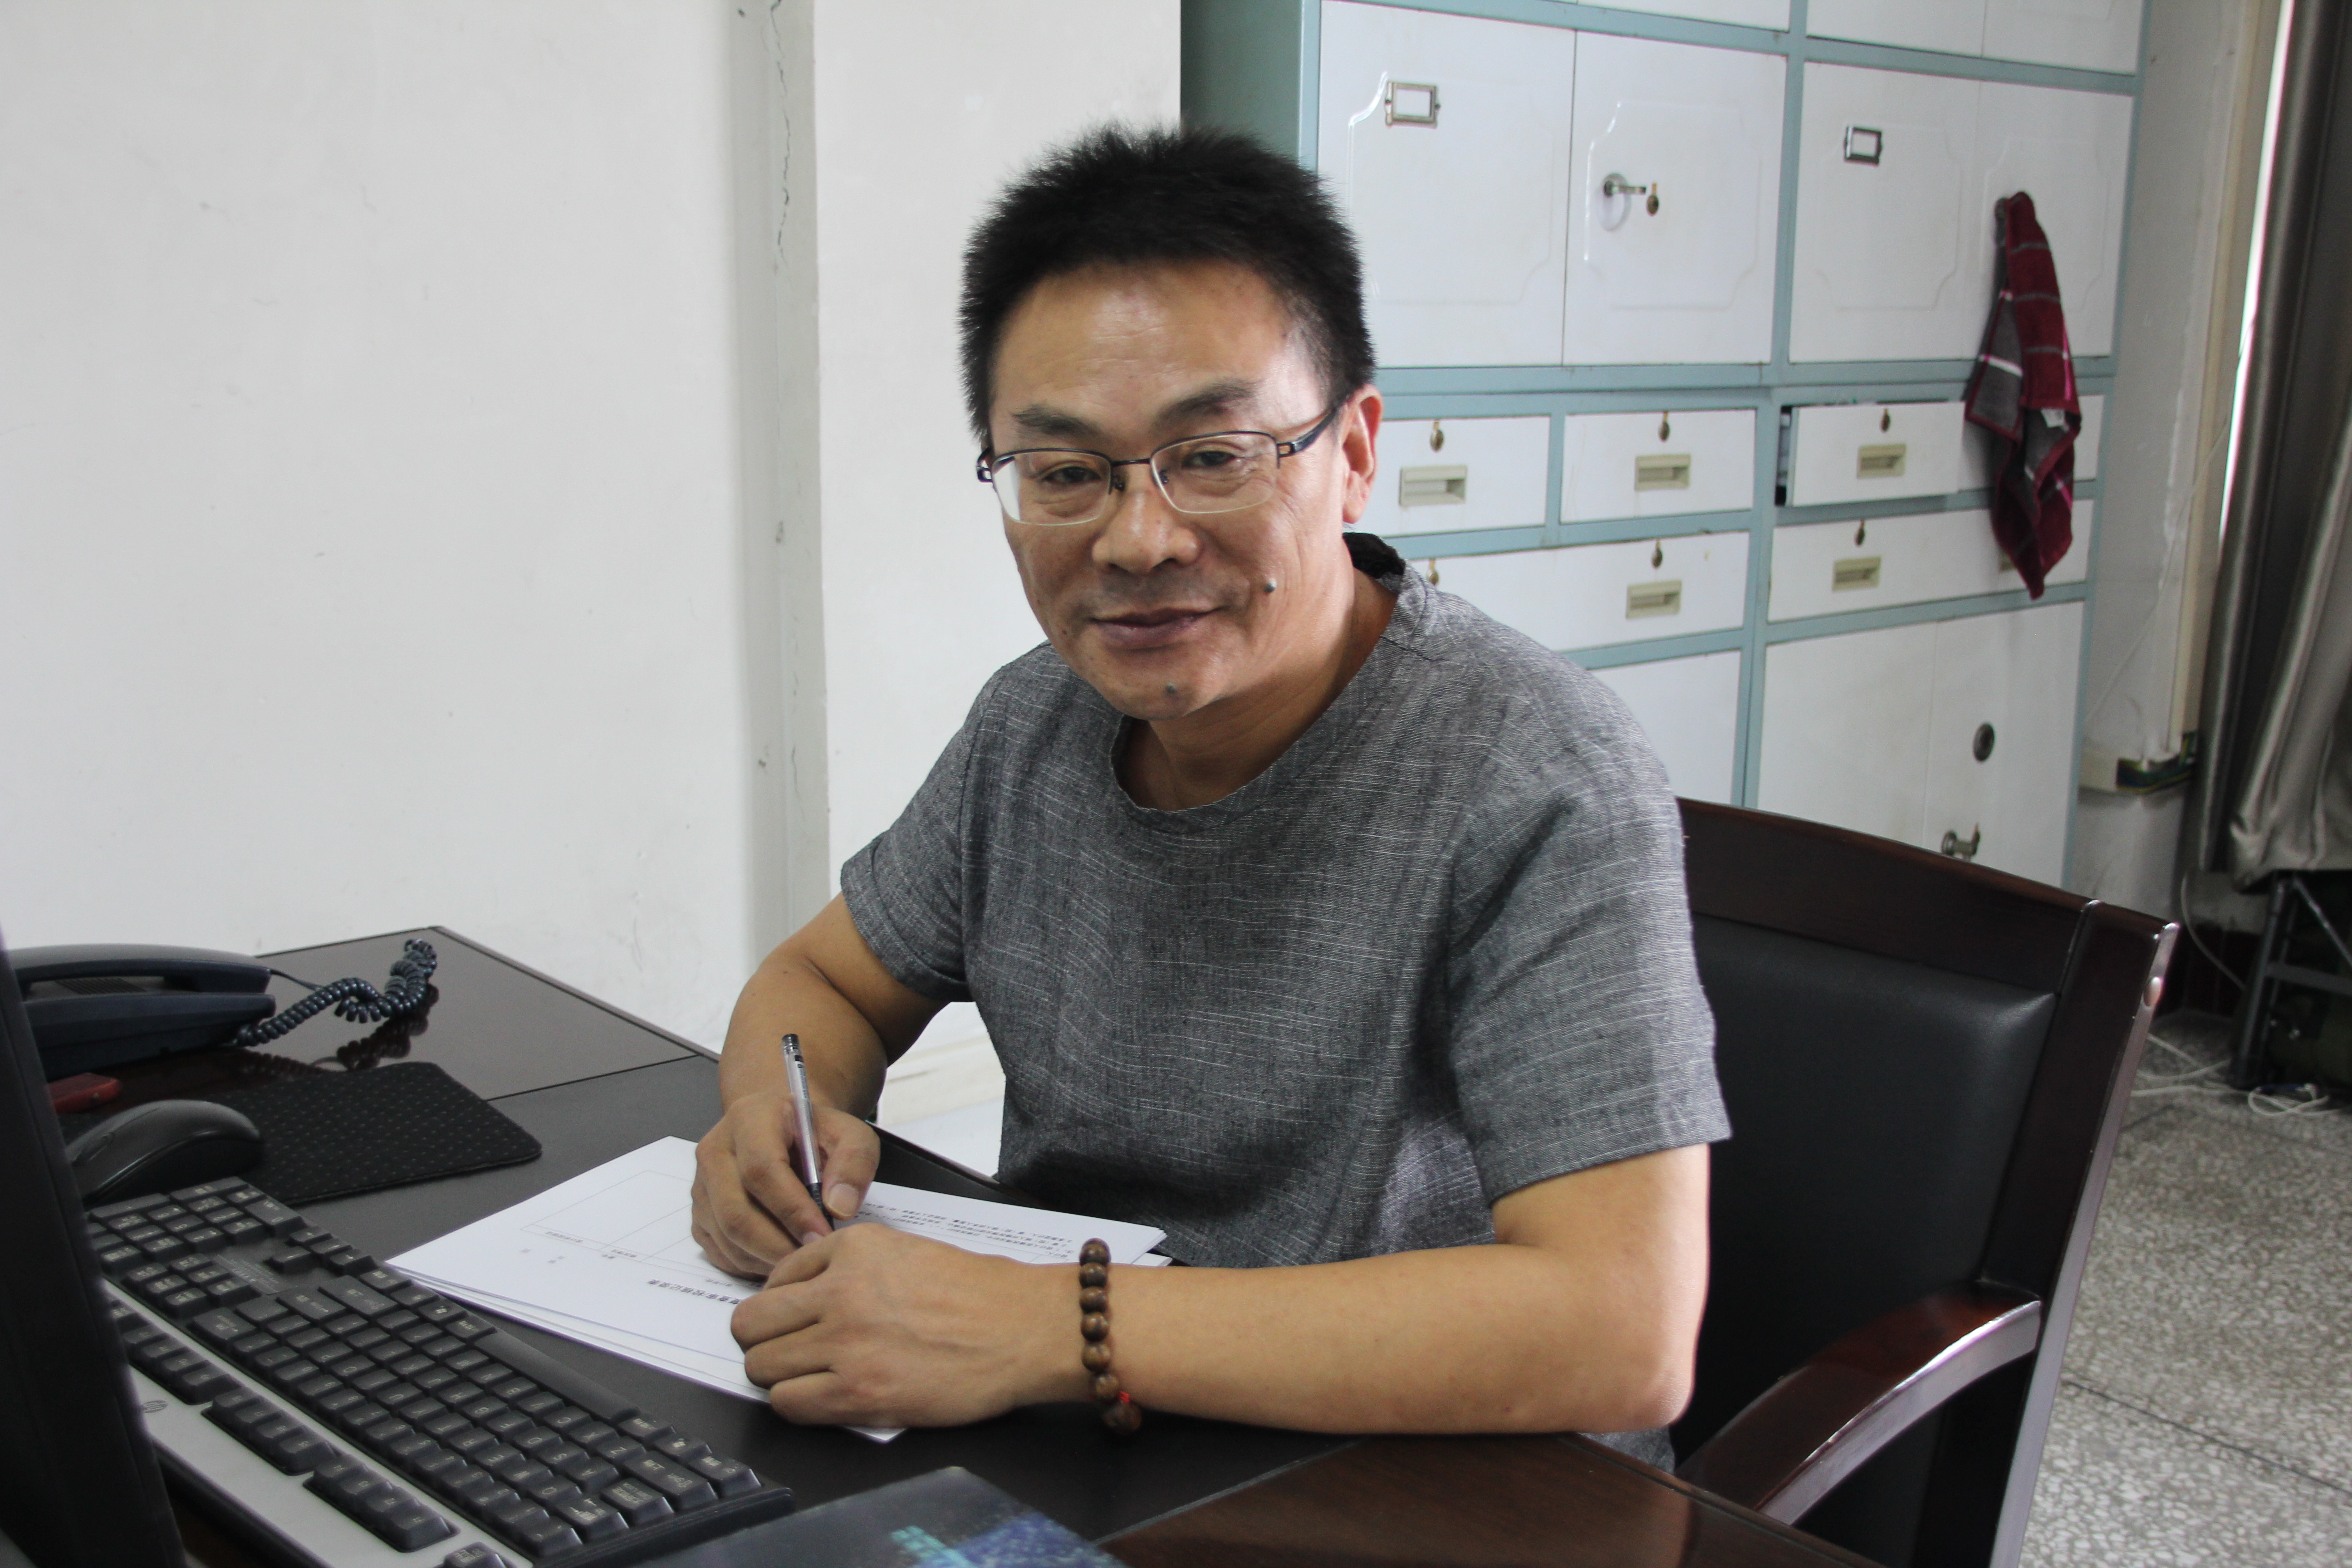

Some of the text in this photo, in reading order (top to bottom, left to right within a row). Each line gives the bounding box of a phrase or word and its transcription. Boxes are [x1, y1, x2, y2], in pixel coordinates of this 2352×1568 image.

[610, 1446, 627, 1455] Z
[488, 1454, 504, 1462] E
[514, 1471, 530, 1479] W
[541, 1486, 557, 1495] Q
